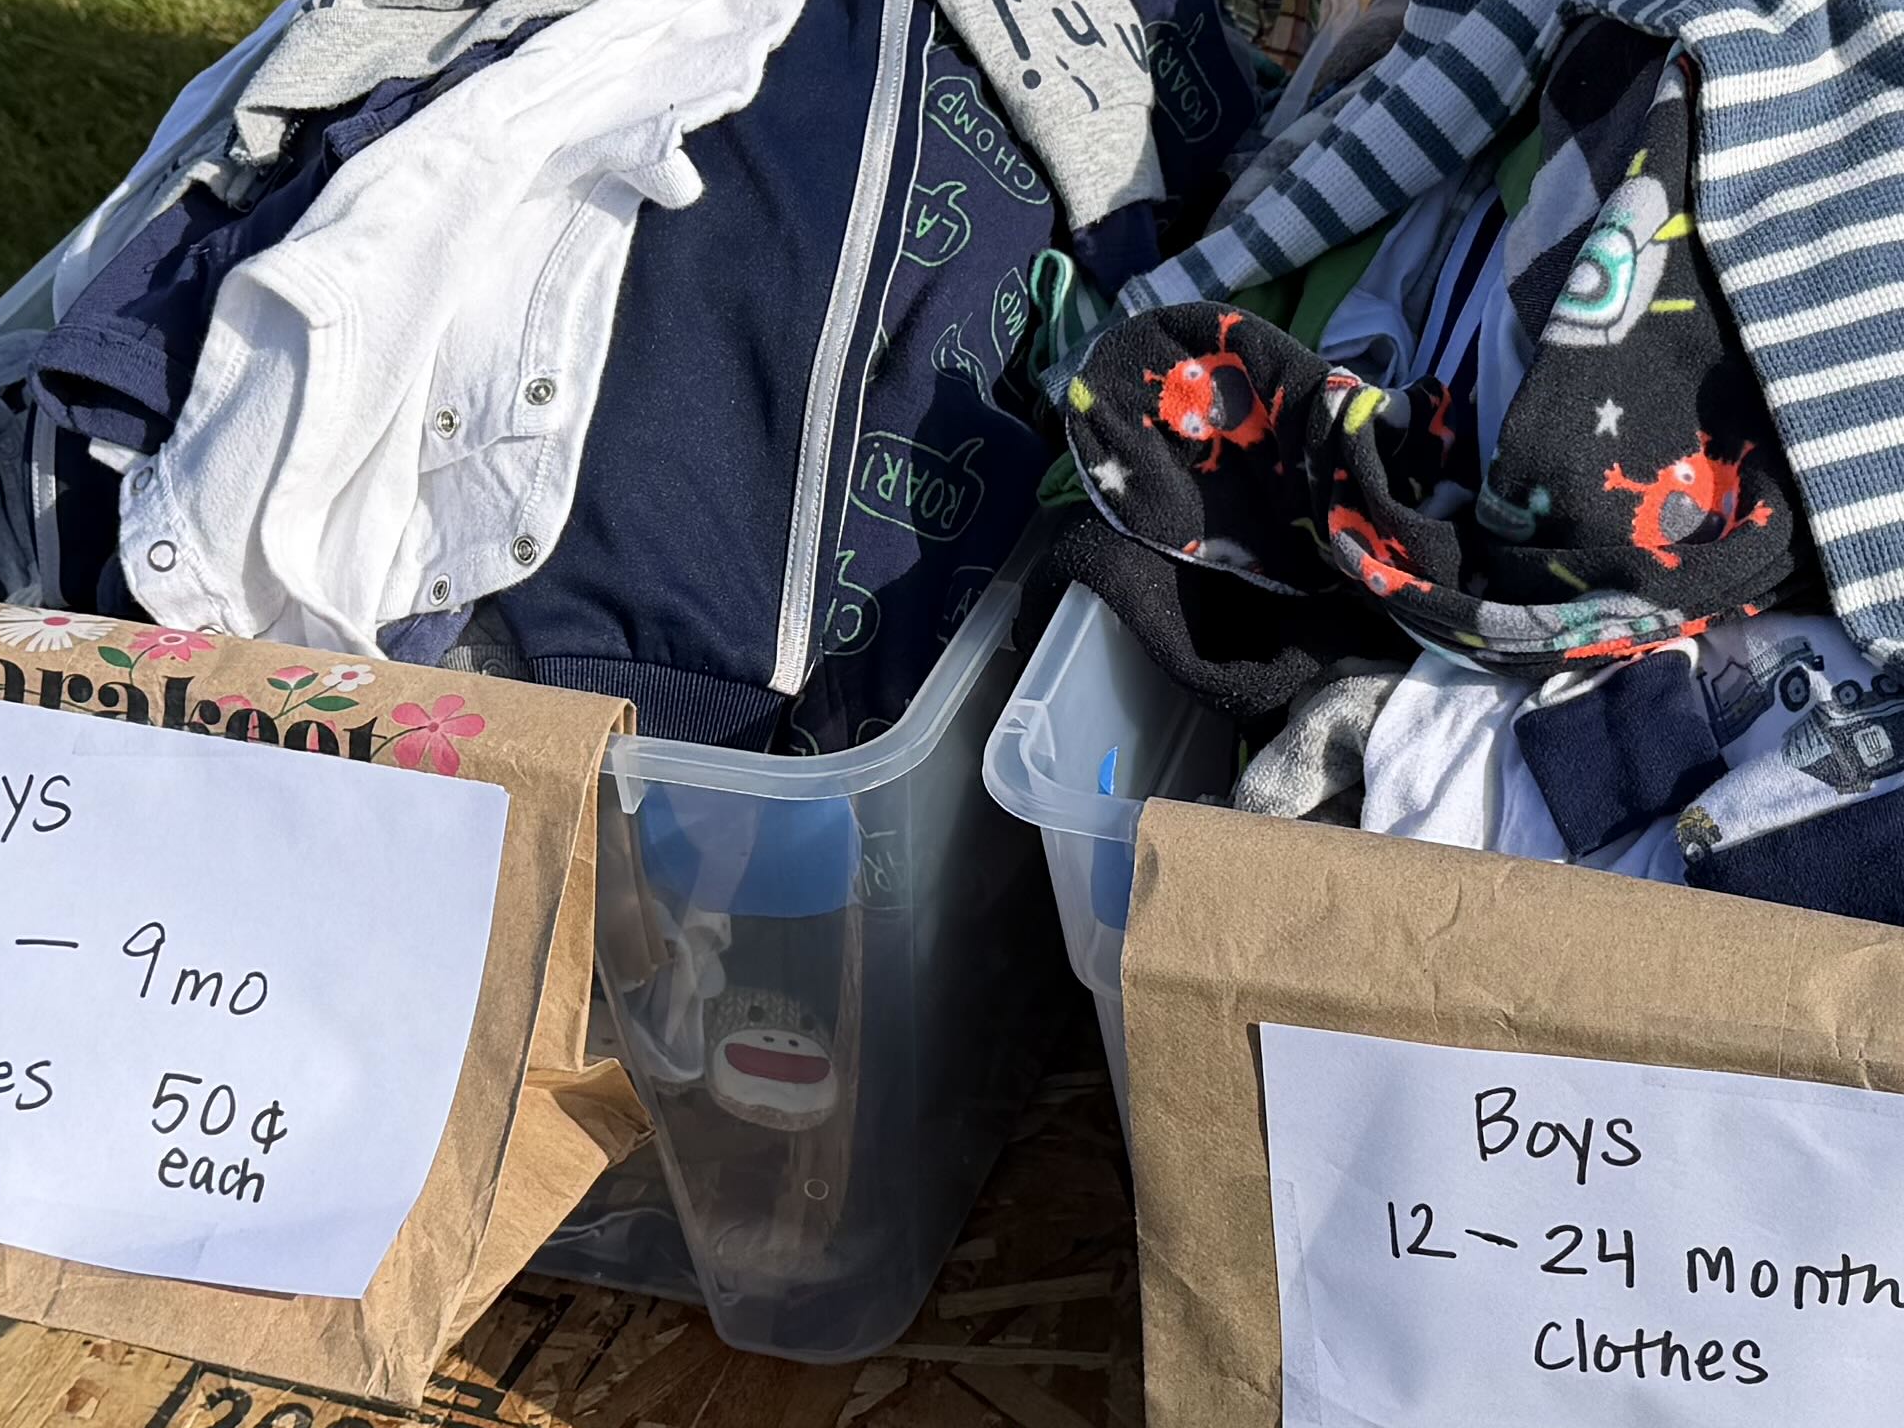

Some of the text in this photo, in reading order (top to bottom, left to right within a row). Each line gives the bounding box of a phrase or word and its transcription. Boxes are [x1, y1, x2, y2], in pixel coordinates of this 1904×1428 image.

[936, 91, 1037, 190] CHOMP
[859, 441, 967, 530] ROAR!
[120, 919, 269, 1020] 9mo
[149, 1070, 289, 1155] 50¢
[1472, 1086, 1643, 1185] Boys
[157, 1144, 265, 1206] each
